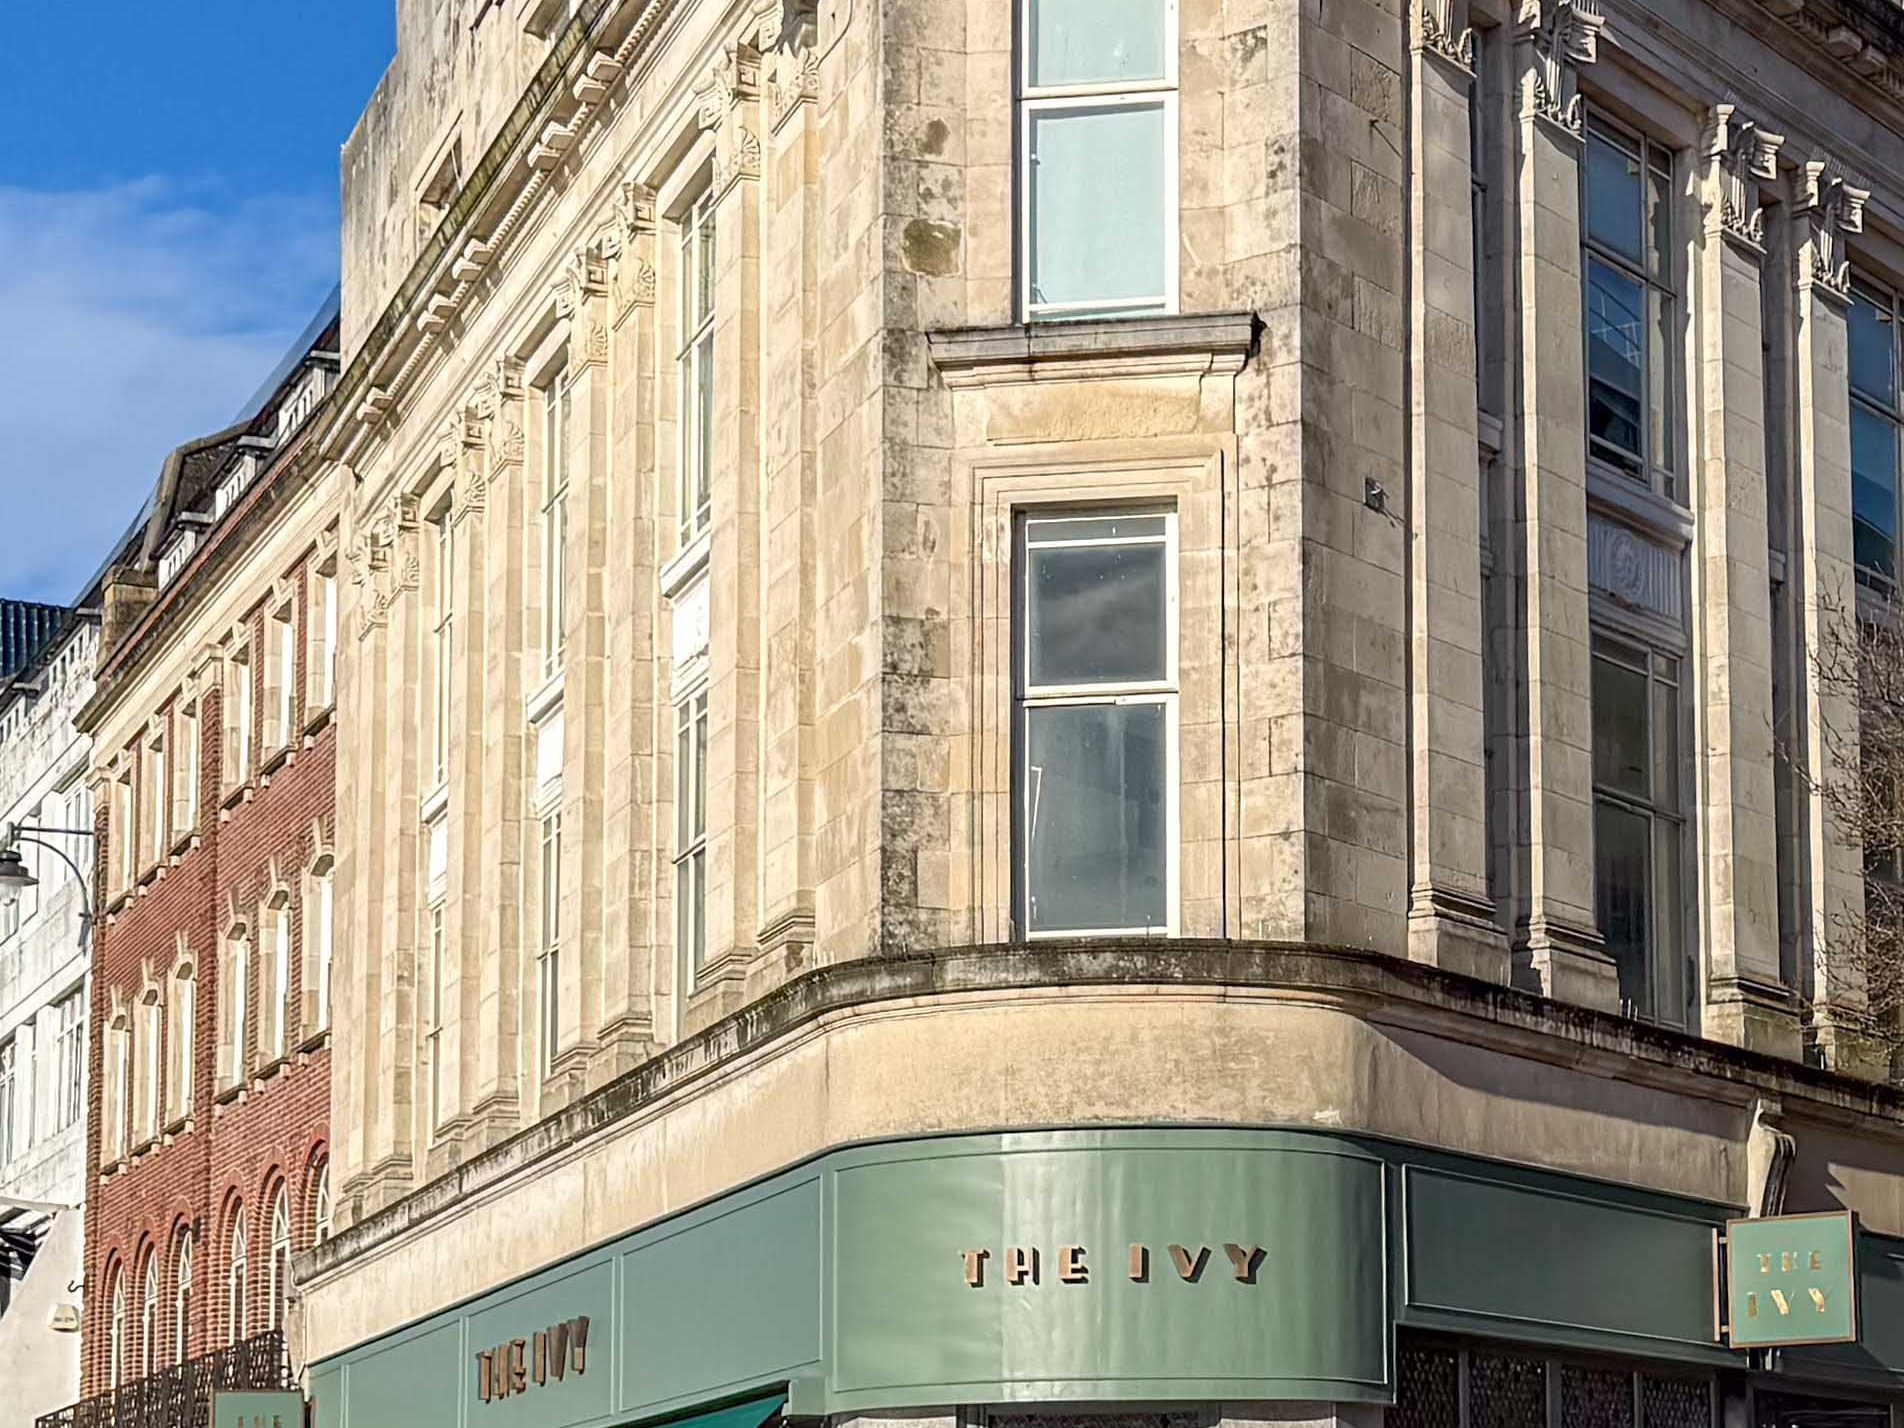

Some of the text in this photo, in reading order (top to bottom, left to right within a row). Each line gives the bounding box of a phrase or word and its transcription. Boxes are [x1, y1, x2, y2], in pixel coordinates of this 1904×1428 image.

[961, 1243, 1268, 1288] THE IVY
[1756, 1250, 1822, 1275] THE
[1746, 1287, 1833, 1318] IVY
[477, 1315, 590, 1404] THE IVY
